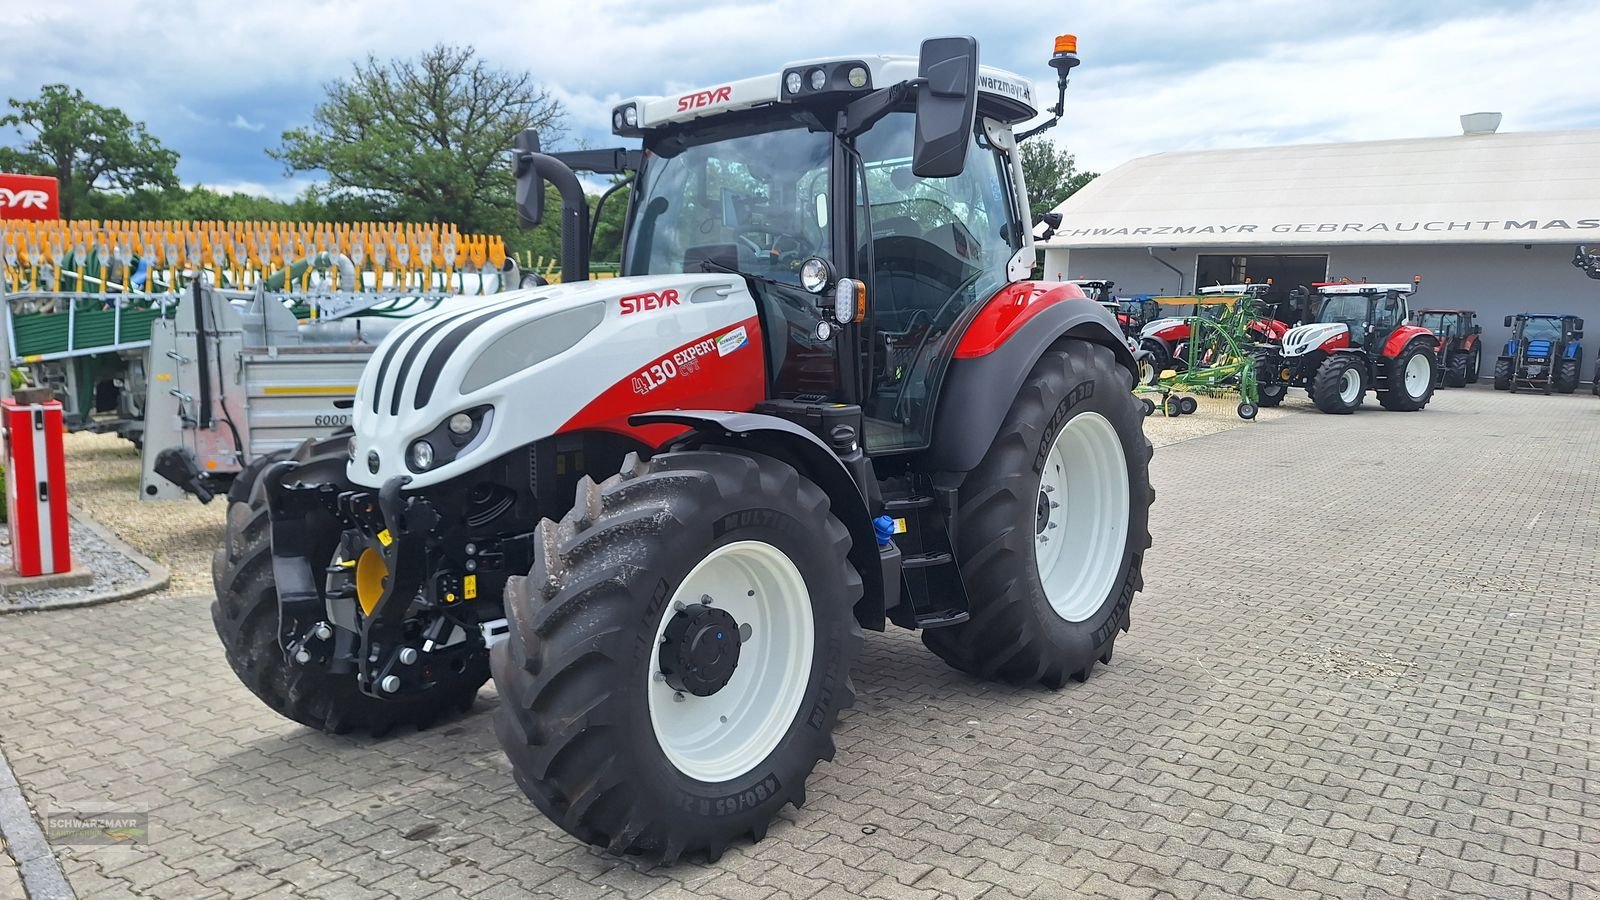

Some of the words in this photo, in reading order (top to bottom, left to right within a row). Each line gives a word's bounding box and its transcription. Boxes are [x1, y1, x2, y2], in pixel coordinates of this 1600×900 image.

[677, 86, 731, 112] STEYR
[1055, 223, 1259, 237] CHWARZMAYR
[619, 289, 680, 315] STEYR
[631, 359, 677, 395] 4130
[673, 338, 717, 366] EXPERT
[679, 360, 700, 377] CVT
[1035, 401, 1067, 469] 600/65
[1069, 394, 1077, 407] R
[699, 799, 710, 816] R
[716, 778, 776, 816] 480/65
